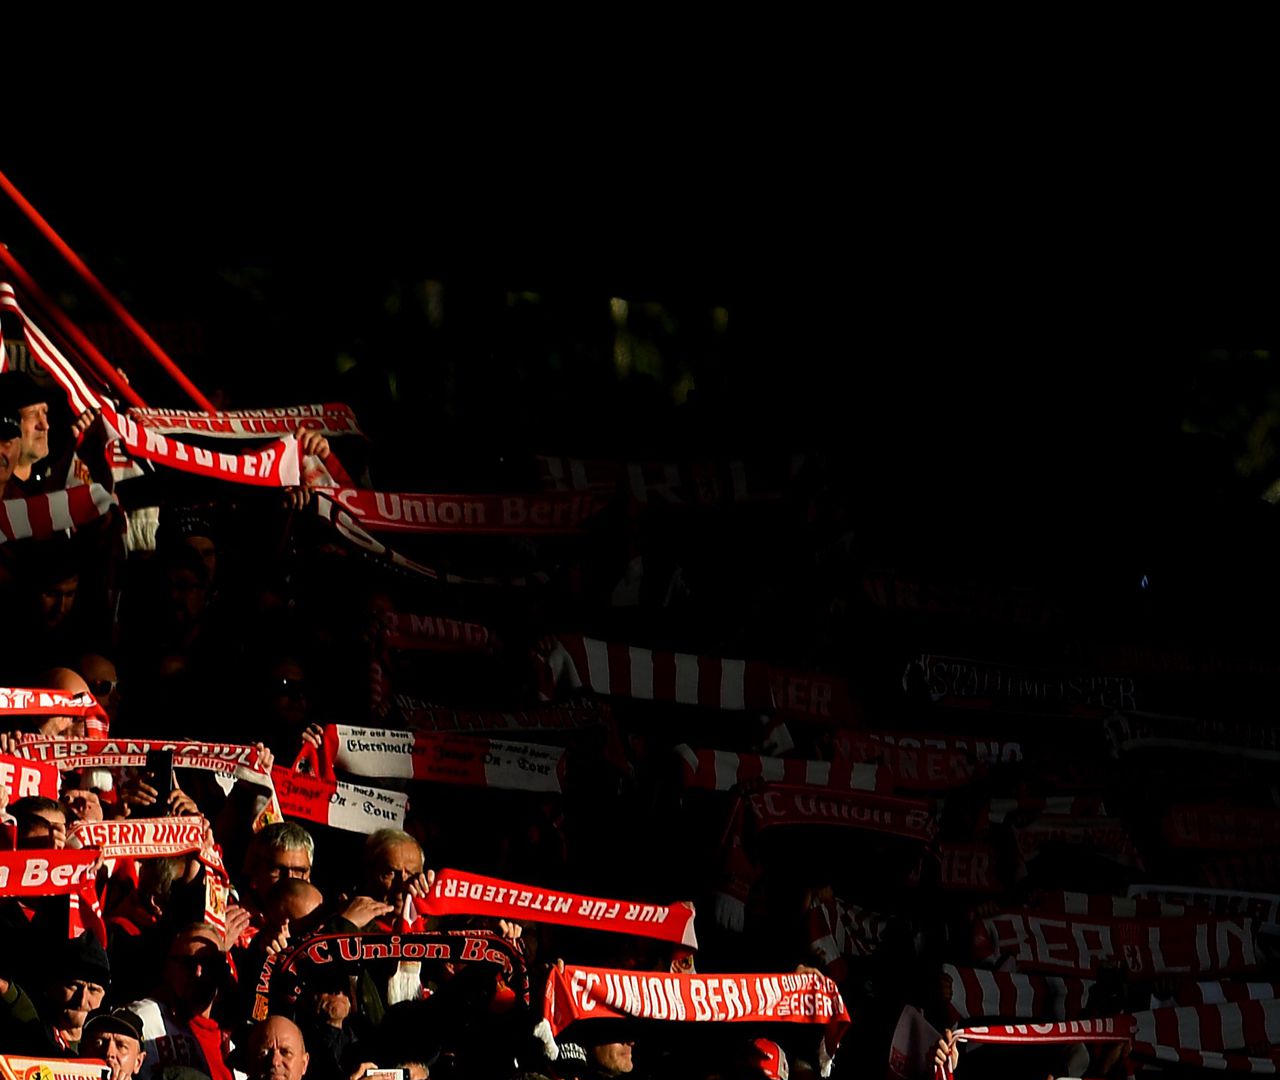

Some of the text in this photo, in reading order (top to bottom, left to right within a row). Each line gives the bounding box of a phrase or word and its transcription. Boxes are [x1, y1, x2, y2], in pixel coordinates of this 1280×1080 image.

[116, 418, 279, 480] UNIONER
[374, 492, 486, 526] Union
[435, 878, 669, 922] NUR FÜR MITGLIEDER!
[339, 936, 452, 960] Union
[988, 914, 1258, 975] BERLIN
[571, 970, 685, 1020] FC UNION
